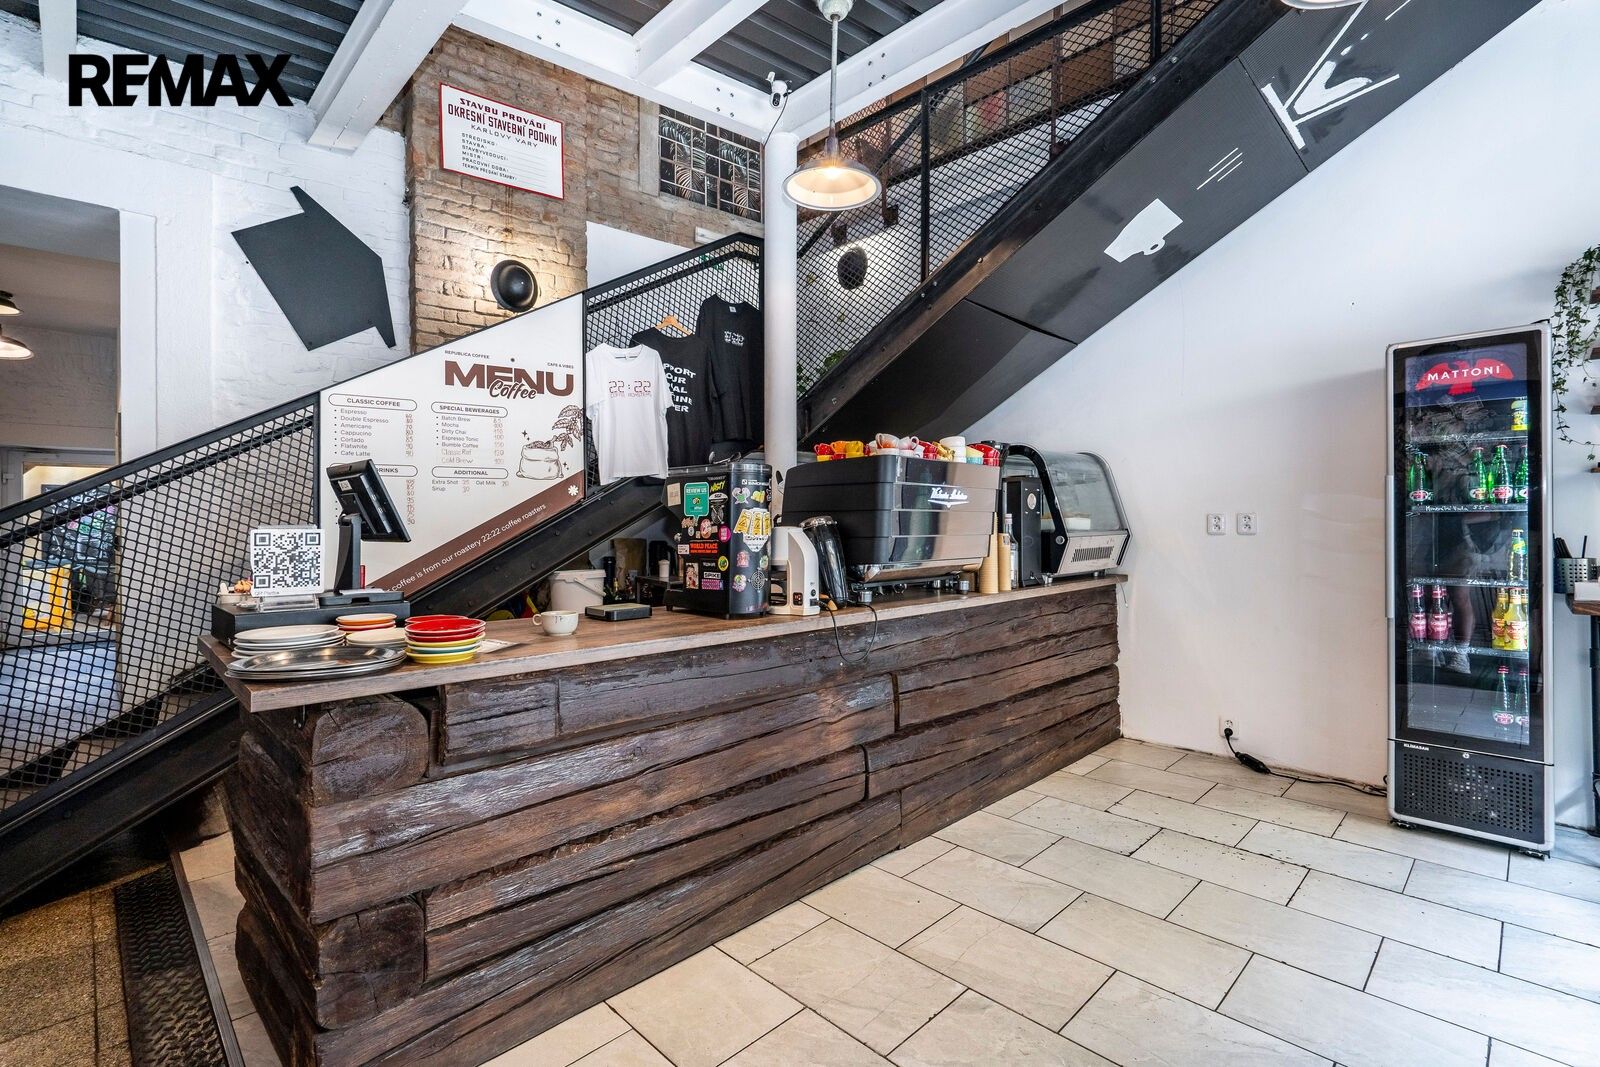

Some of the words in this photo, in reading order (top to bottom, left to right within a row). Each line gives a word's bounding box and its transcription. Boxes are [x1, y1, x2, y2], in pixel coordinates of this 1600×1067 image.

[459, 98, 498, 115] STAVBU
[502, 111, 546, 130] PROVÁDÍ
[447, 103, 487, 125] OKRESNÍ
[488, 115, 527, 137] STAVEBNÍ
[528, 128, 558, 147] PODNIK
[471, 124, 511, 140] KARLOVY
[515, 137, 538, 147] VARY
[445, 360, 574, 397] MENU
[663, 362, 696, 379] PPORT
[665, 372, 687, 385] OUR
[1427, 365, 1500, 381] MATTONI
[489, 379, 537, 399] Coffee
[346, 397, 375, 405] CLASSIC
[391, 575, 416, 591] coffee
[422, 560, 441, 574] from
[441, 554, 454, 565] our
[454, 538, 482, 558] roastery
[480, 527, 501, 543] 22:22
[500, 516, 522, 532] coffee
[521, 502, 547, 520] roasters
